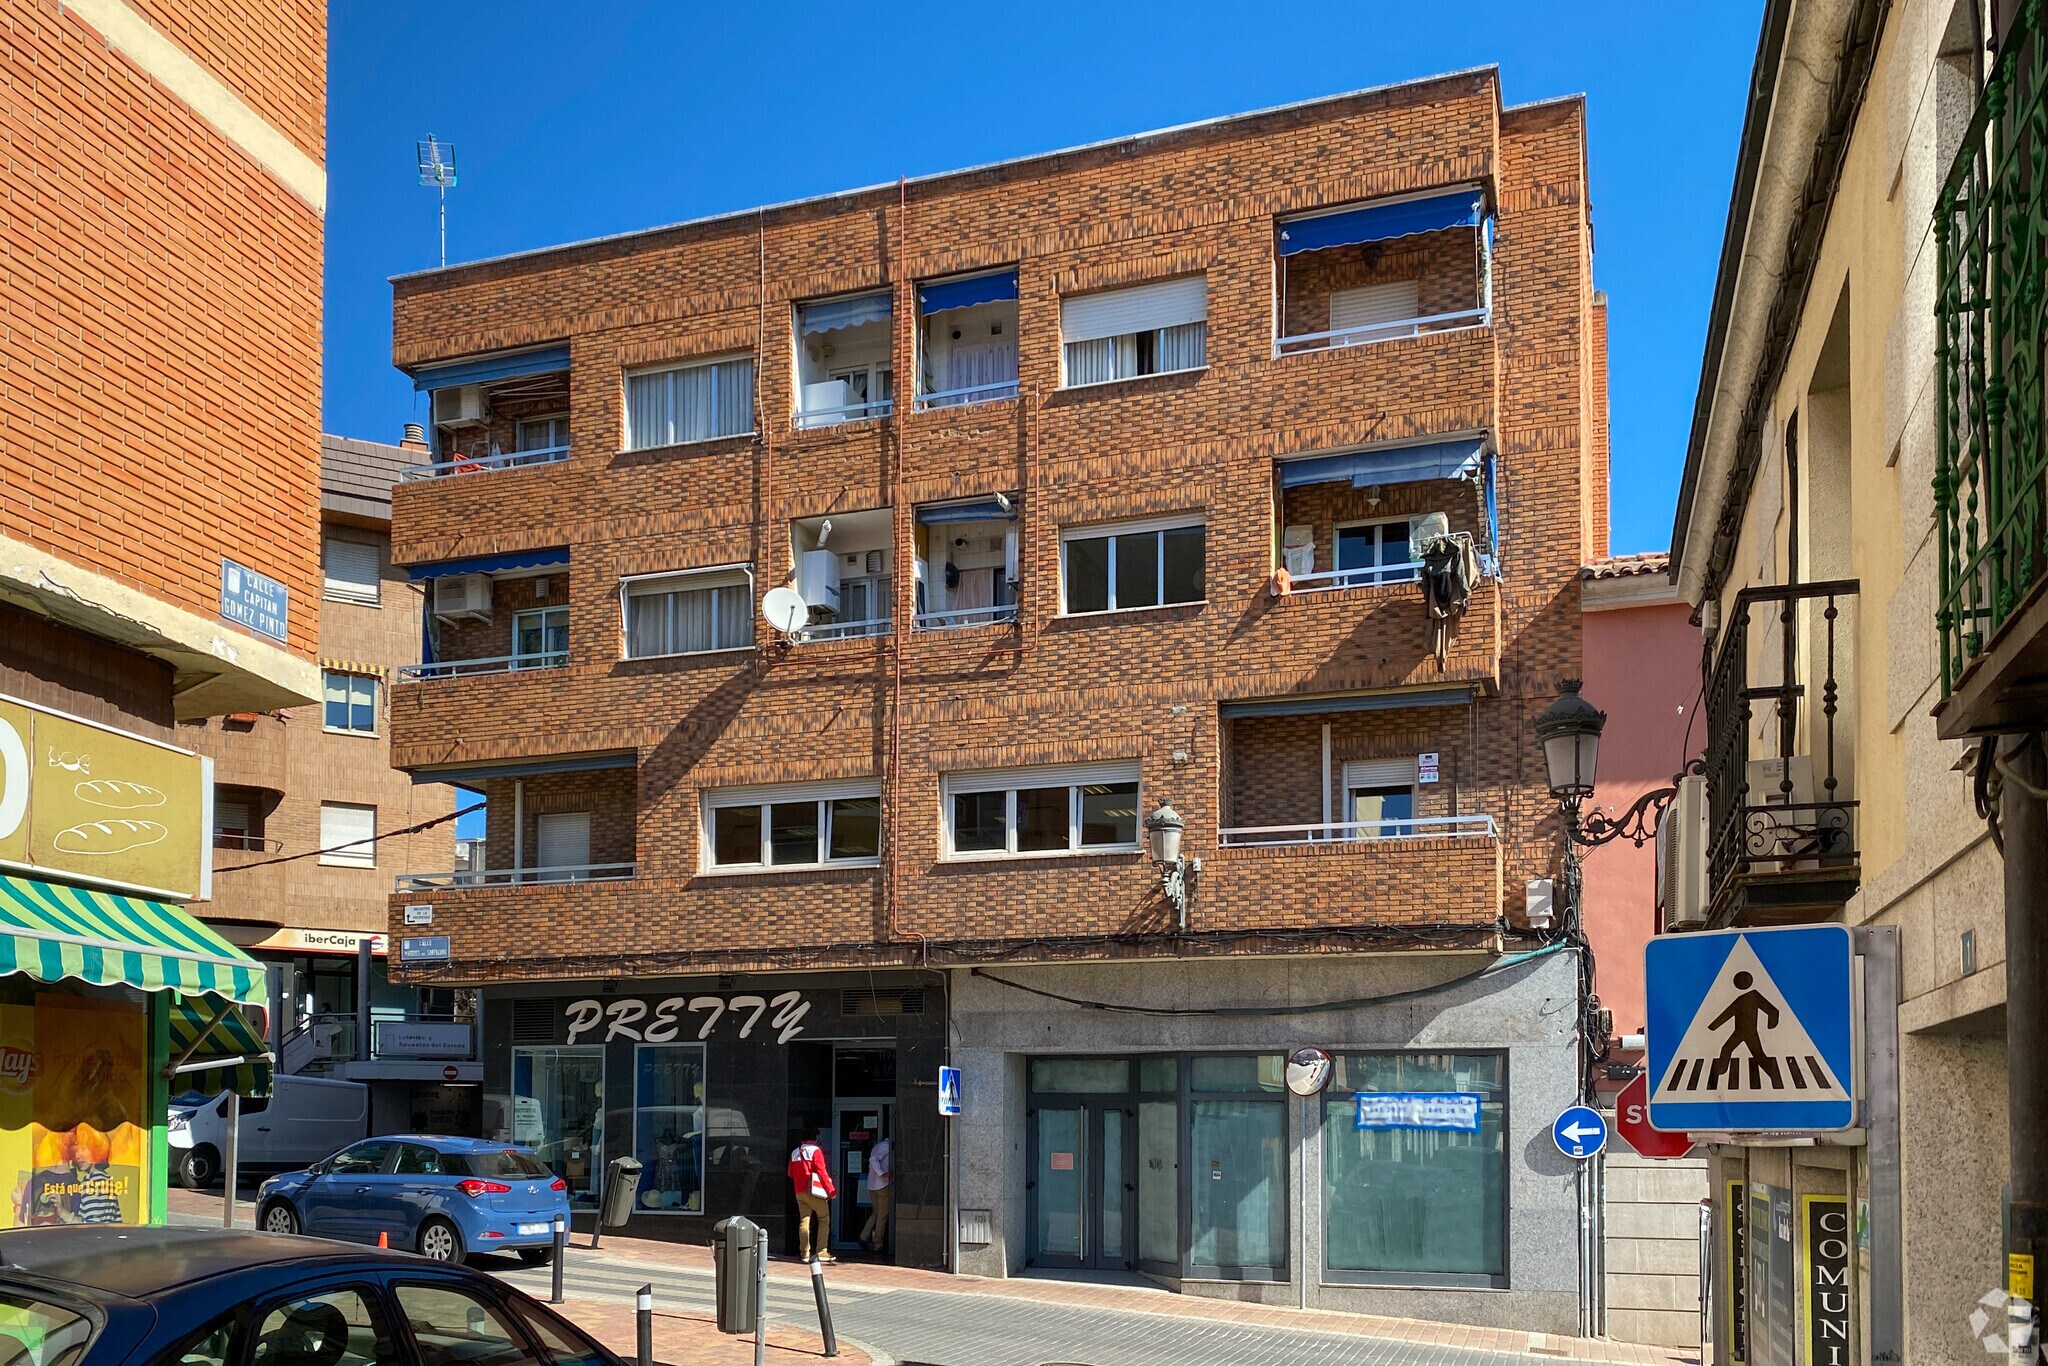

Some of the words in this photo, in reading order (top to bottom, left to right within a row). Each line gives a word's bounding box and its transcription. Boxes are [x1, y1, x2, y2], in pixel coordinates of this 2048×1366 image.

[247, 574, 274, 597] CALLE
[244, 590, 278, 616] CAPITAN
[224, 598, 254, 624] GOMEZ
[259, 613, 285, 637] PINTO
[305, 933, 356, 947] iberCaja
[564, 990, 812, 1046] PRETTY
[44, 1182, 65, 1195] Está
[67, 1184, 84, 1196] que
